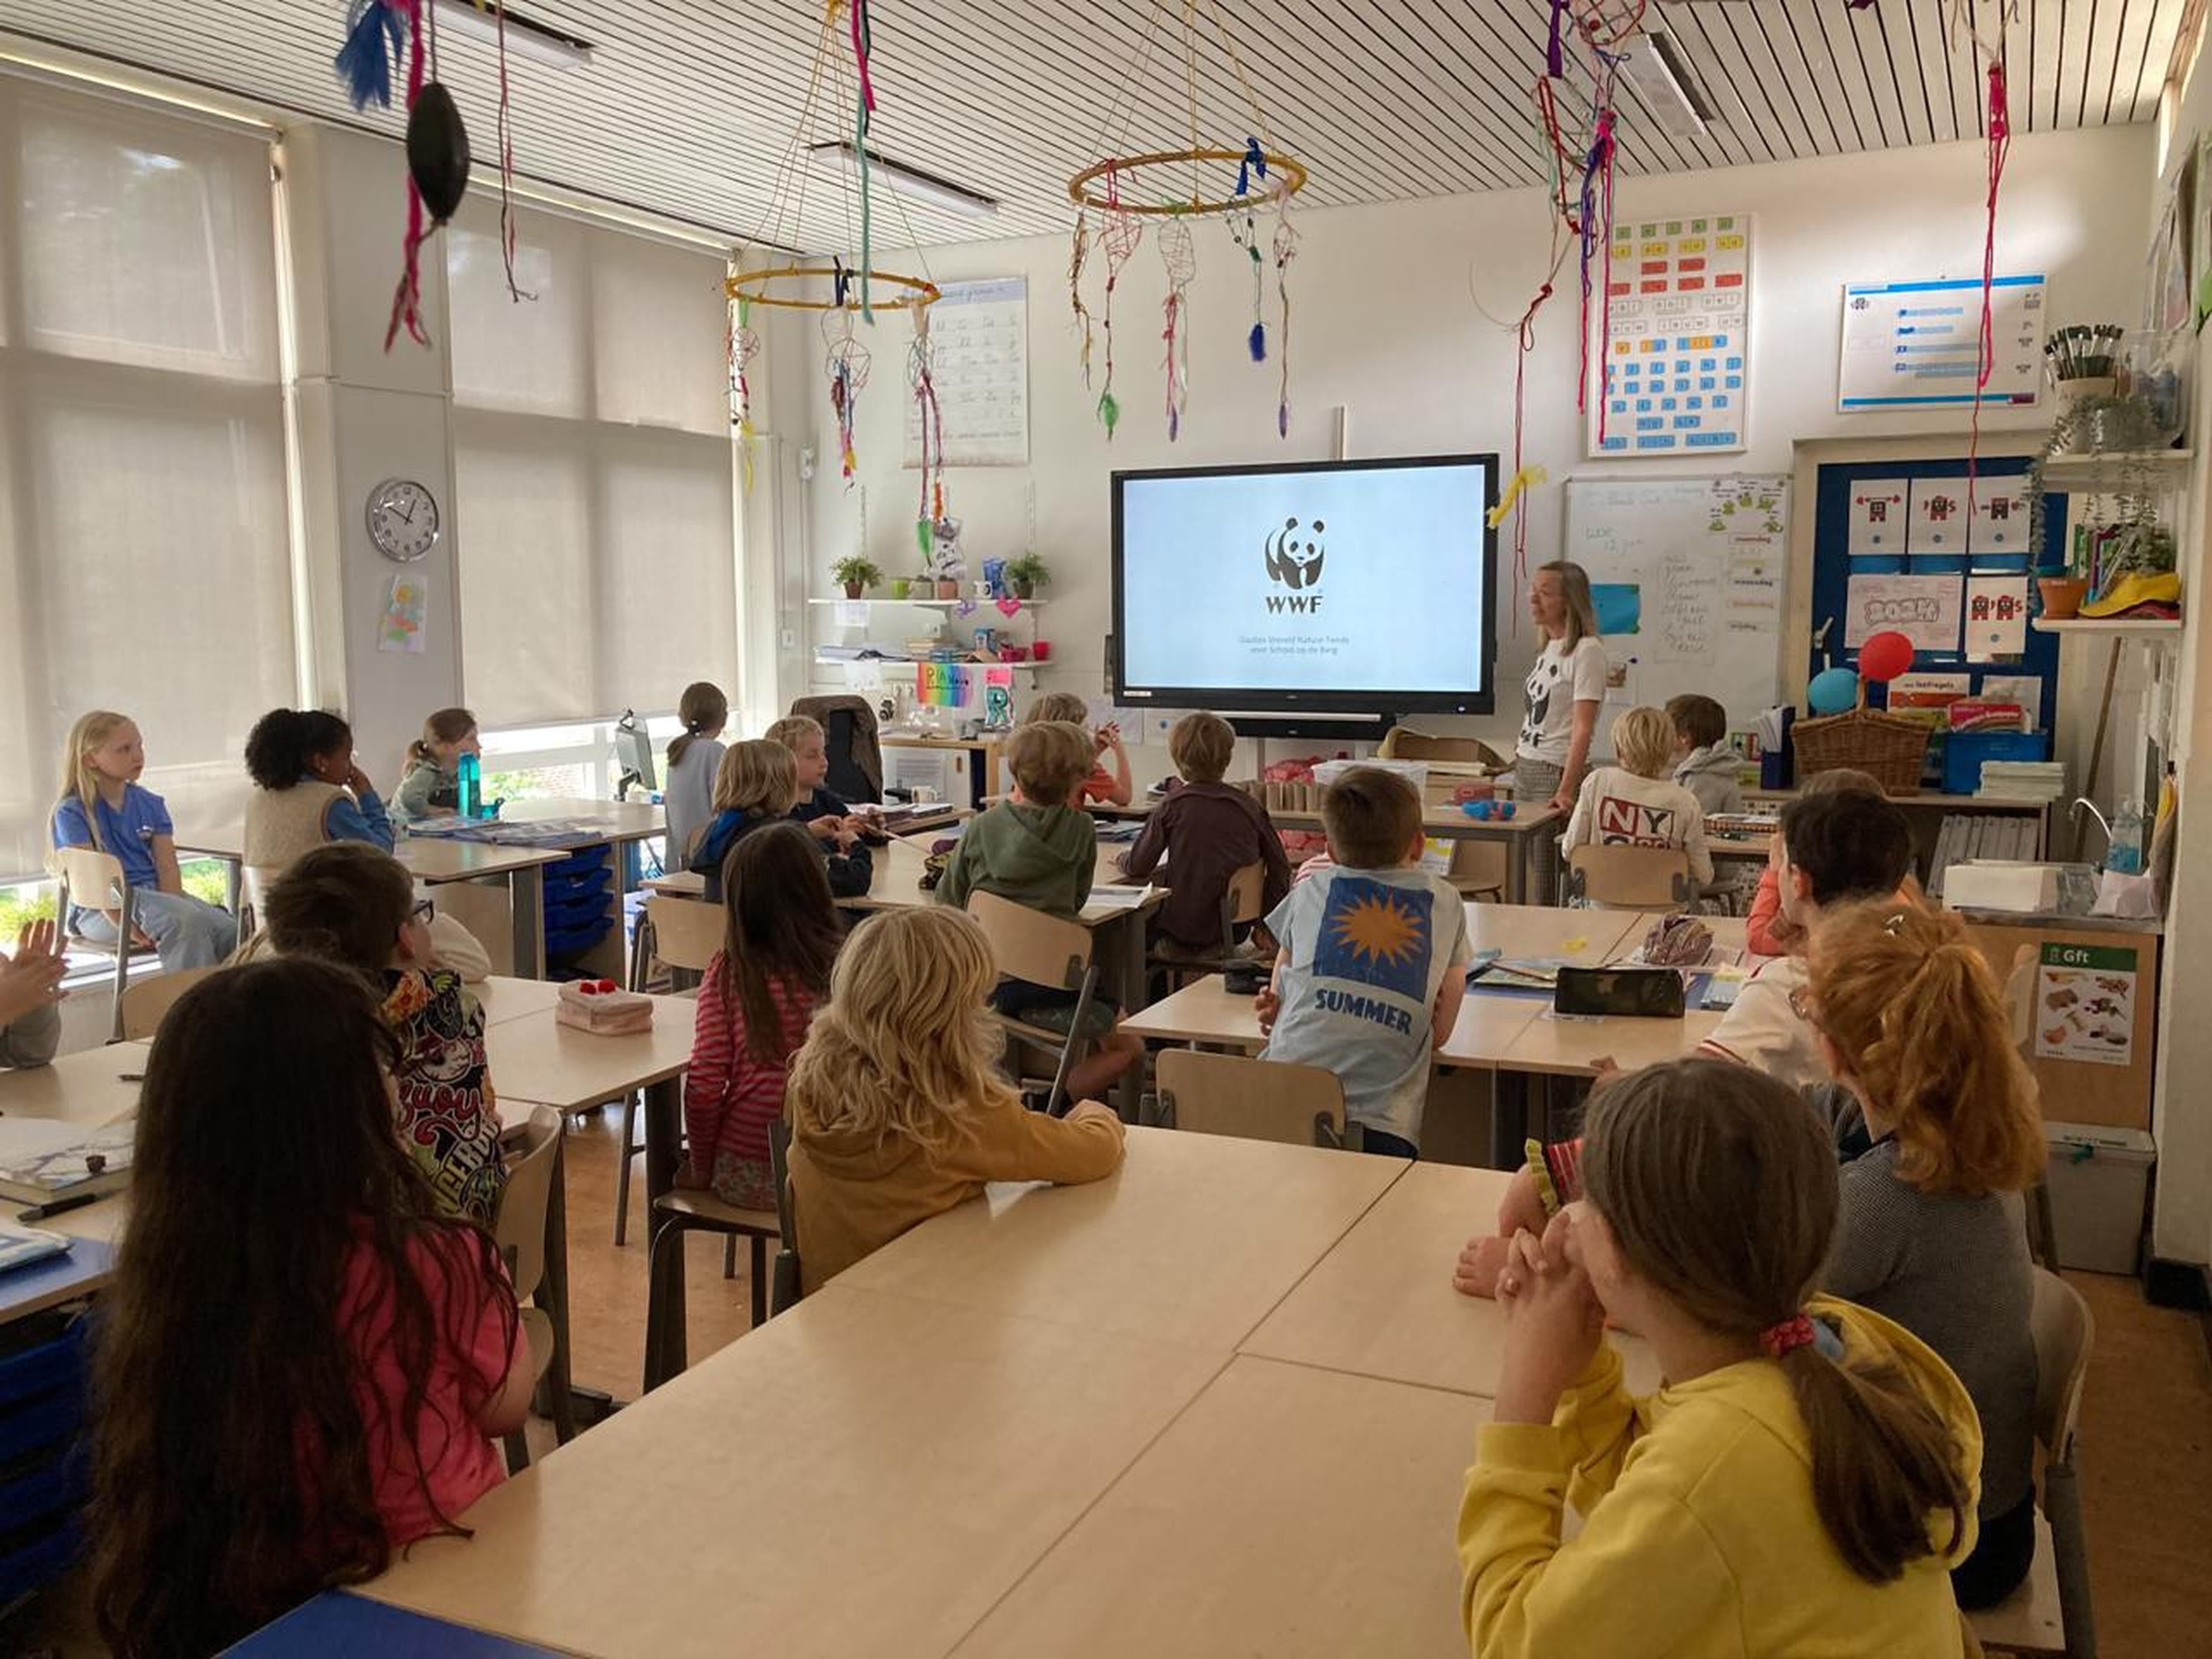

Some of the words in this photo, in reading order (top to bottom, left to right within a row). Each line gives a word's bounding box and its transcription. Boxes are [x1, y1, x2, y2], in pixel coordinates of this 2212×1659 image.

[1266, 596, 1323, 615] WWF
[1602, 800, 1668, 835] NY
[2063, 949, 2090, 964] Gft
[1314, 987, 1413, 1035] SUMMER
